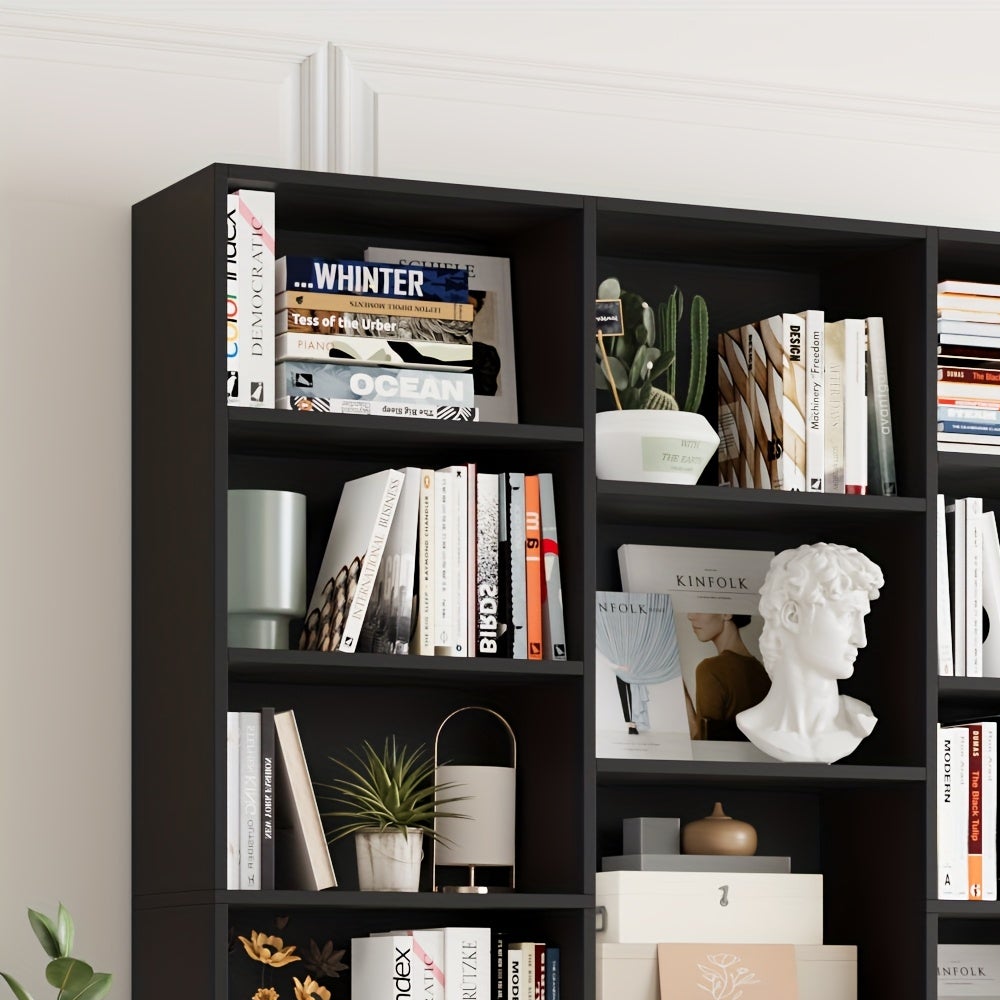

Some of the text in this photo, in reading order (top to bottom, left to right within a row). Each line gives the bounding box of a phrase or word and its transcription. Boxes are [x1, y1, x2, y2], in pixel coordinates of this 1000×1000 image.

[251, 217, 264, 356] DEMOCRATIC
[350, 301, 385, 310] MOMENTS
[292, 313, 396, 332] Tess of the Urber
[789, 325, 801, 362] DESIGN
[350, 372, 464, 401] OCEAN
[810, 331, 821, 430] Machinery Freedom
[946, 371, 964, 379] DUMAS
[972, 372, 984, 381] The
[382, 405, 434, 416] The Big Sleep
[662, 453, 680, 463] THE
[351, 478, 400, 621] INTERNATIONAL BUSINESS
[676, 575, 749, 590] KINFOLK
[971, 817, 979, 842] Tulip
